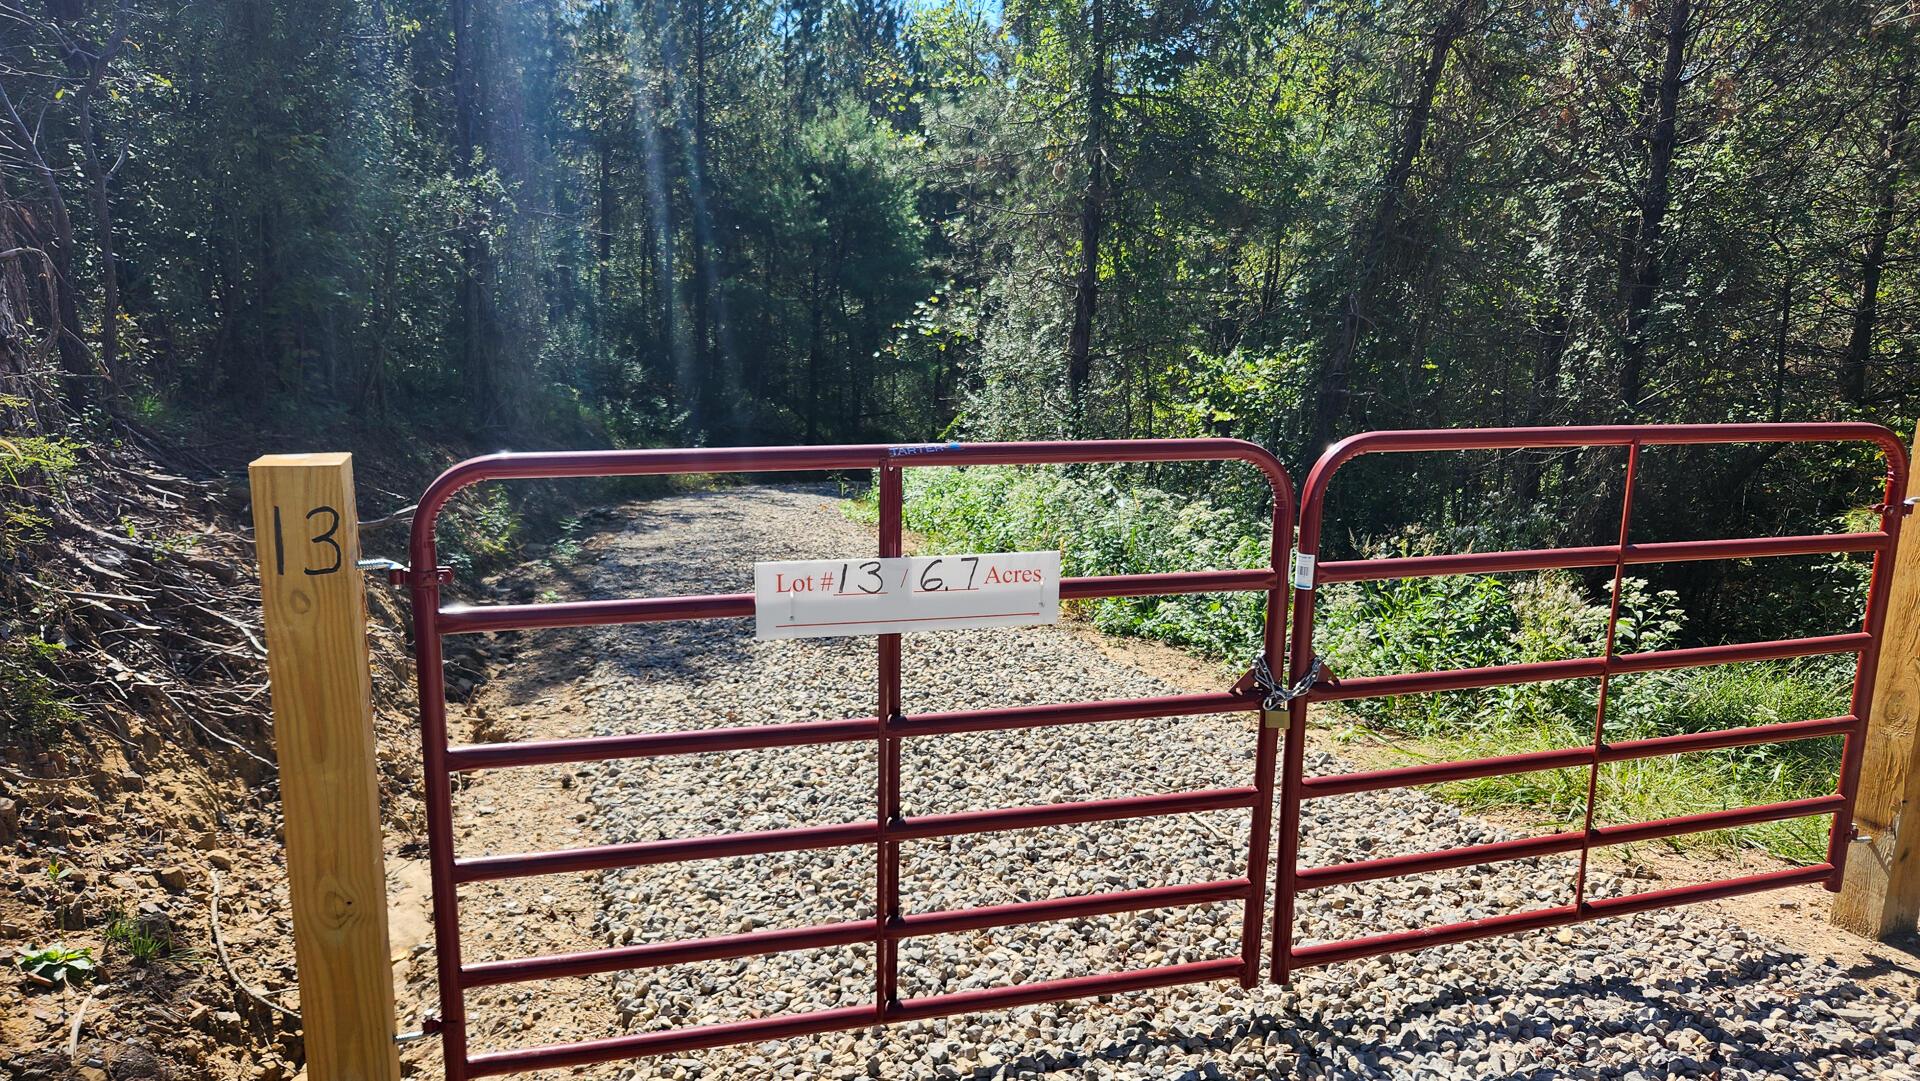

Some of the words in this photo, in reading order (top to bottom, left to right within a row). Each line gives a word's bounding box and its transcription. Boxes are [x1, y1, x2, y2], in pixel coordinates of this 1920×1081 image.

[888, 446, 944, 456] TARTER
[274, 505, 341, 575] 13
[775, 573, 813, 593] Lot
[920, 557, 979, 591] 6.7
[984, 565, 1042, 585] Acres
